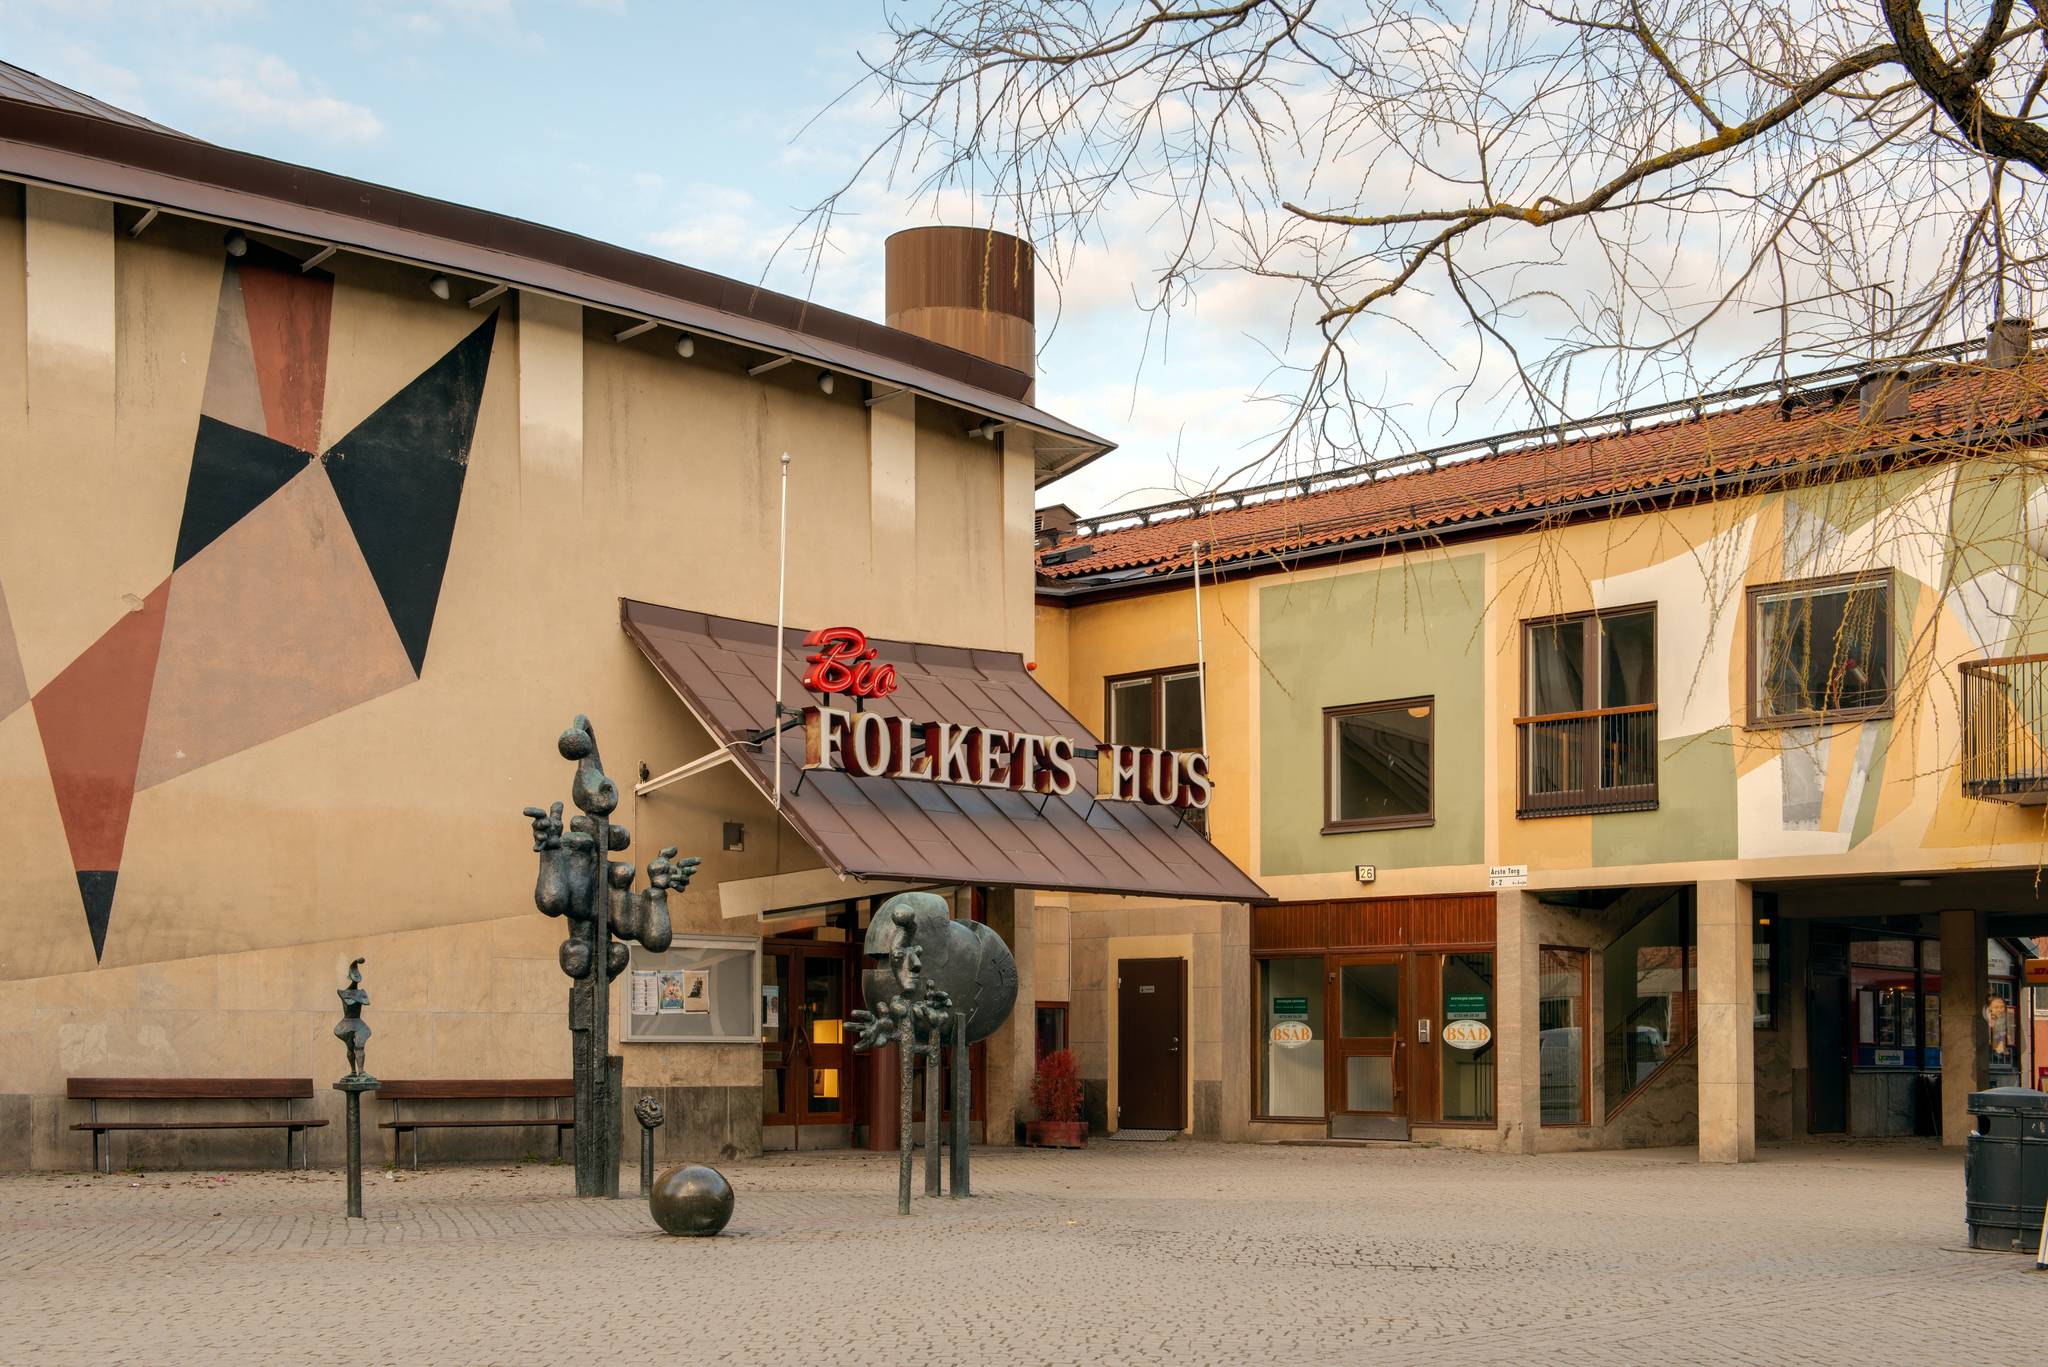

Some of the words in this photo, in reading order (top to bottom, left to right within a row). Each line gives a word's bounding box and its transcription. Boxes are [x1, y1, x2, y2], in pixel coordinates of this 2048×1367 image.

[803, 627, 898, 698] Bio
[804, 705, 1077, 796] FOLKETS
[1097, 744, 1212, 809] HUS
[1360, 868, 1373, 879] 26
[1508, 867, 1520, 876] Torg
[1273, 1028, 1311, 1041] BSAB
[1446, 1027, 1489, 1041] BSAB
